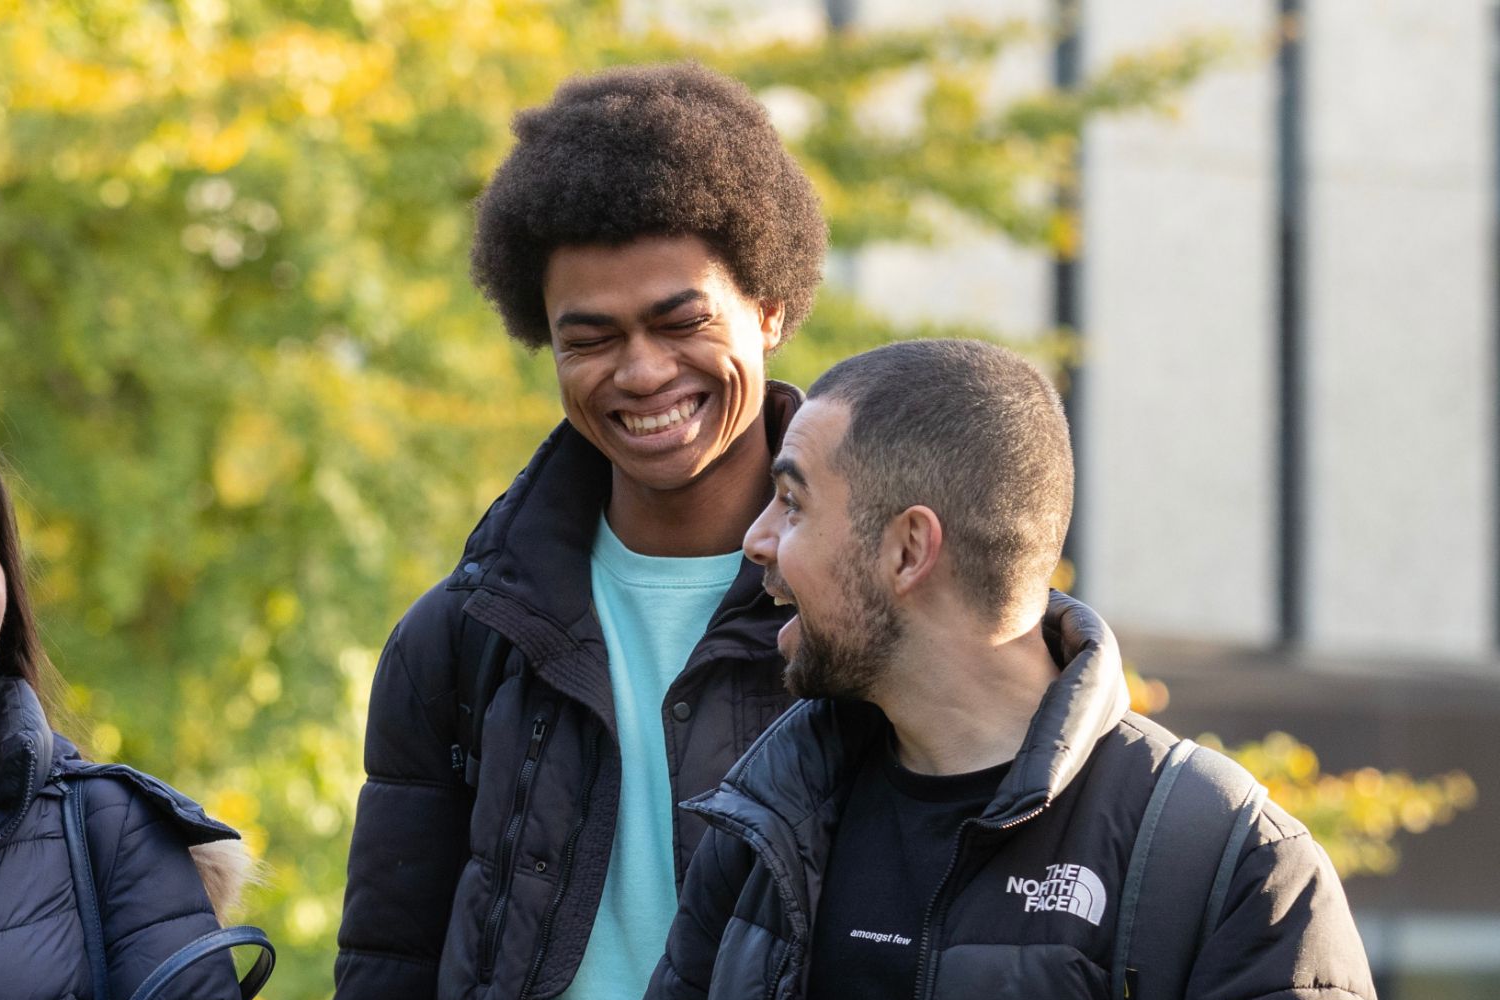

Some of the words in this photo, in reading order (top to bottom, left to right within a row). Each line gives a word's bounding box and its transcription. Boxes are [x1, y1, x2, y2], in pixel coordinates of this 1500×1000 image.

[1046, 863, 1080, 880] THE
[1005, 876, 1075, 897] NORTH
[1024, 895, 1069, 912] FACE
[850, 929, 893, 943] amongst
[892, 934, 912, 945] few
